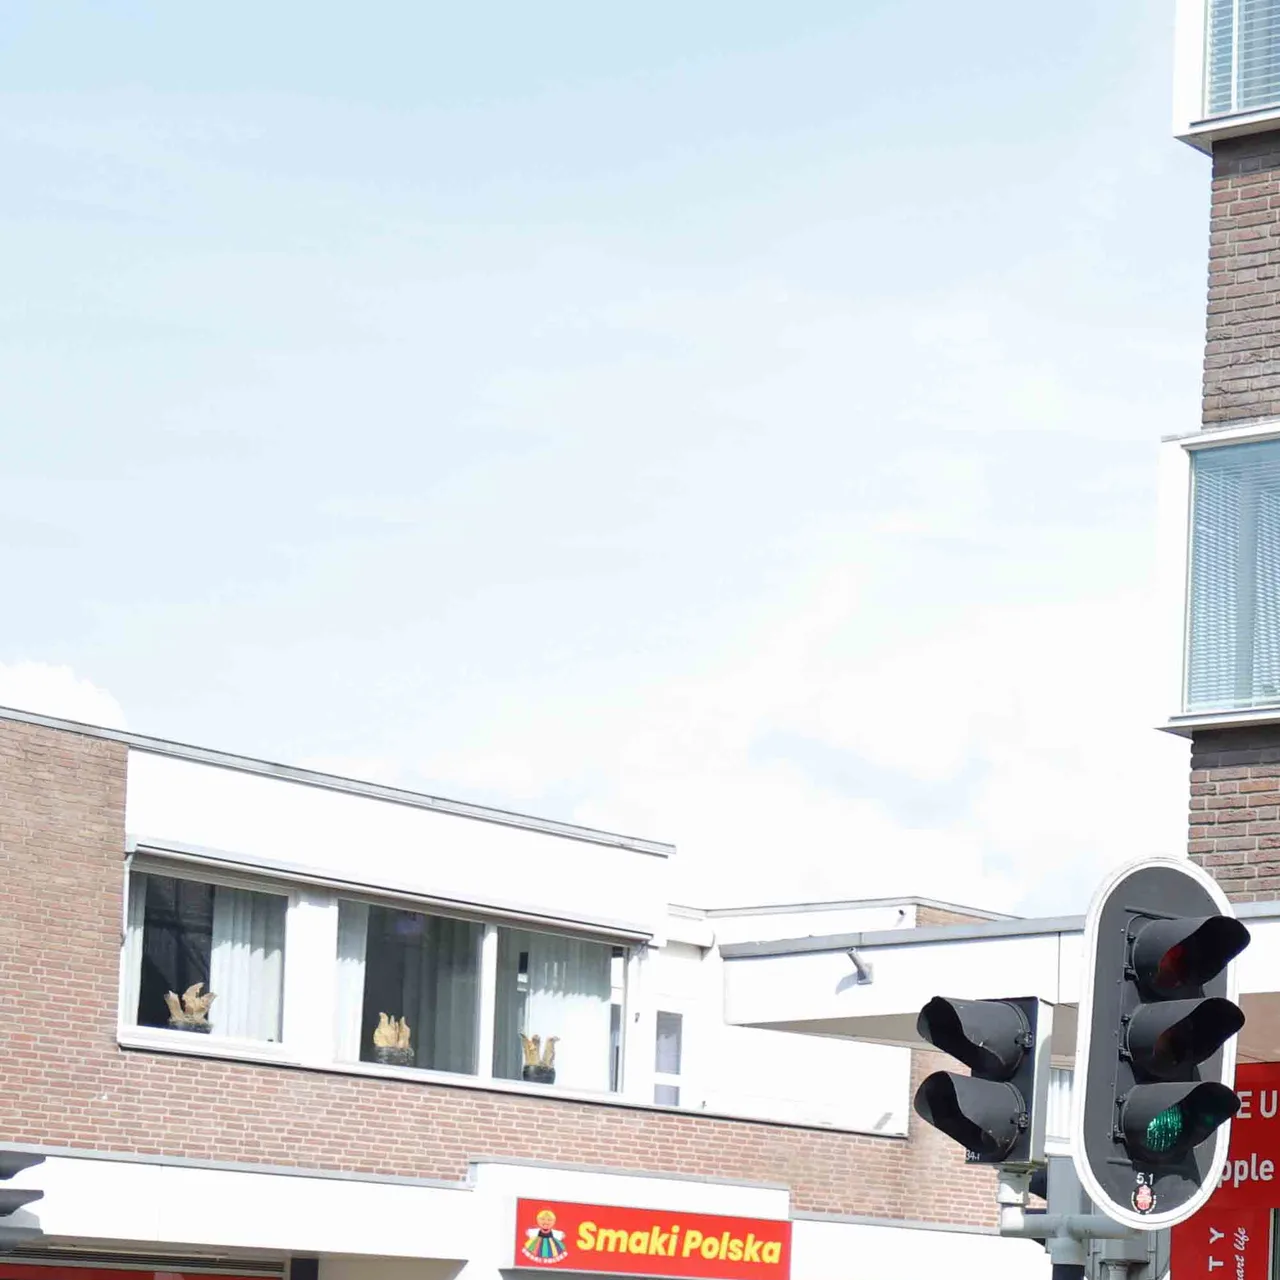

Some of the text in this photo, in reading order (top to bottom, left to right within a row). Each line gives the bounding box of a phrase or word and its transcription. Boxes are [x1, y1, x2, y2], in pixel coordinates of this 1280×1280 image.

[1136, 1172, 1154, 1186] 5.1
[1217, 1152, 1275, 1188] pple
[576, 1221, 782, 1264] Smaki Polska
[1234, 1226, 1250, 1251] life
